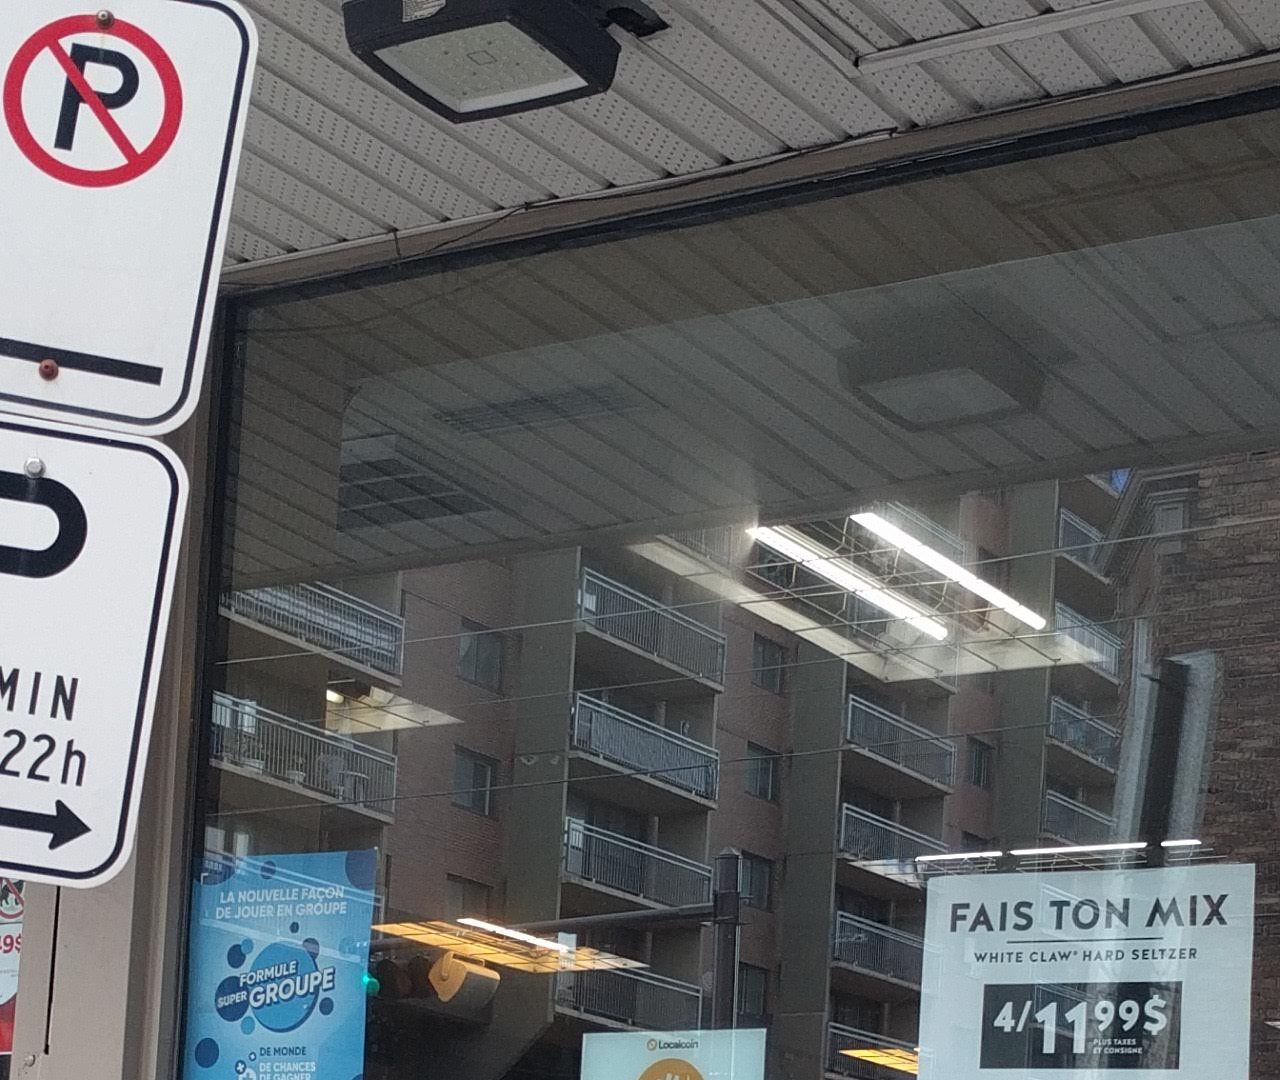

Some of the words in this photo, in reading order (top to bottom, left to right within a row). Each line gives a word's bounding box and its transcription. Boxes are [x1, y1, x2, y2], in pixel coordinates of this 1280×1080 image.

[220, 891, 235, 904] LA
[237, 889, 299, 904] NOUVELLE
[301, 886, 345, 904] FAÇON
[215, 907, 232, 920] DE
[234, 905, 275, 919] JOUER
[277, 904, 293, 918] EN
[295, 902, 348, 916] GROUPE
[949, 901, 1034, 933] FAIS
[1048, 898, 1131, 931] TON
[1145, 894, 1229, 928] MIX
[974, 951, 1023, 963] WHITE
[1082, 949, 1125, 962] HARD
[1131, 948, 1198, 960] SELTZER
[239, 960, 298, 988] FORMULE
[217, 990, 248, 1009] SUPER
[248, 967, 335, 1009] GROUPE
[658, 1039, 699, 1050] Localcoin
[1093, 1038, 1112, 1046] PLUS
[1113, 1038, 1137, 1046] TAXES
[259, 1047, 271, 1057] DE
[273, 1046, 307, 1057] MONDE
[1103, 1047, 1143, 1055] CONSIGNE
[259, 1062, 271, 1073] DE
[273, 1061, 316, 1073] CHANCES
